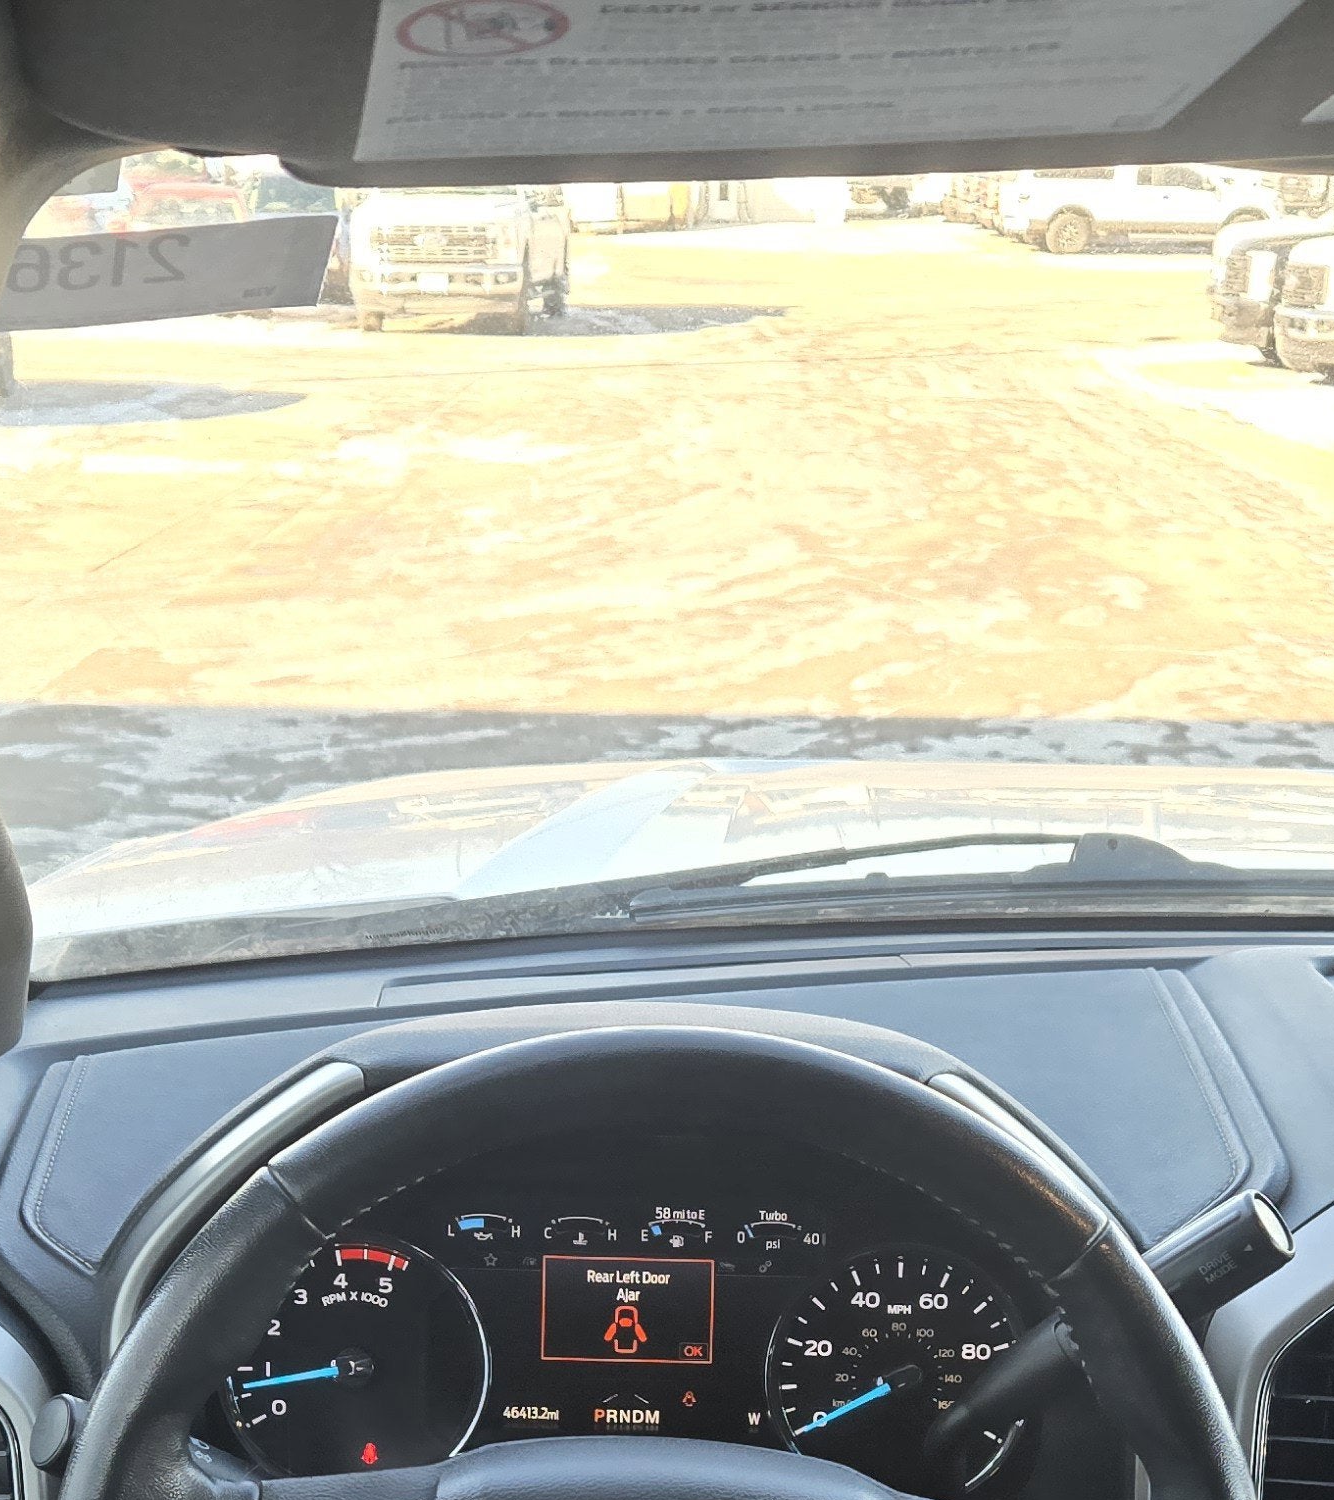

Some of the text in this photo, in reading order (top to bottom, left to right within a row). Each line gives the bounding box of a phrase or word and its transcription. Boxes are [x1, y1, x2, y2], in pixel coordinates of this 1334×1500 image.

[655, 1206, 706, 1221] 58 mi to E
[758, 1210, 788, 1222] Turbo
[447, 1224, 455, 1237] L
[511, 1225, 521, 1238] H
[543, 1226, 552, 1239] C
[607, 1228, 617, 1241] H
[641, 1229, 649, 1242] E
[704, 1230, 713, 1244] F
[765, 1238, 781, 1251] psi
[803, 1232, 820, 1245] 40
[333, 1273, 349, 1289] 4
[586, 1269, 671, 1285] Rear Left Door
[378, 1277, 393, 1294] 5
[293, 1288, 308, 1305] 3
[321, 1289, 391, 1308] RPM X 1000
[616, 1287, 641, 1304] Ajar
[850, 1291, 881, 1309] 40
[918, 1293, 949, 1310] 60
[887, 1304, 912, 1315] MPH
[267, 1319, 281, 1336] 2
[861, 1327, 878, 1339] 60
[891, 1321, 907, 1333] 80
[915, 1327, 935, 1339] 100
[683, 1345, 703, 1361] OK
[803, 1339, 834, 1358] 20
[841, 1345, 858, 1357] 40
[938, 1348, 955, 1358] 120
[961, 1343, 992, 1361] 80
[834, 1373, 849, 1382] 20
[944, 1374, 963, 1383] 140
[271, 1399, 287, 1416] 0
[747, 1412, 761, 1426] W
